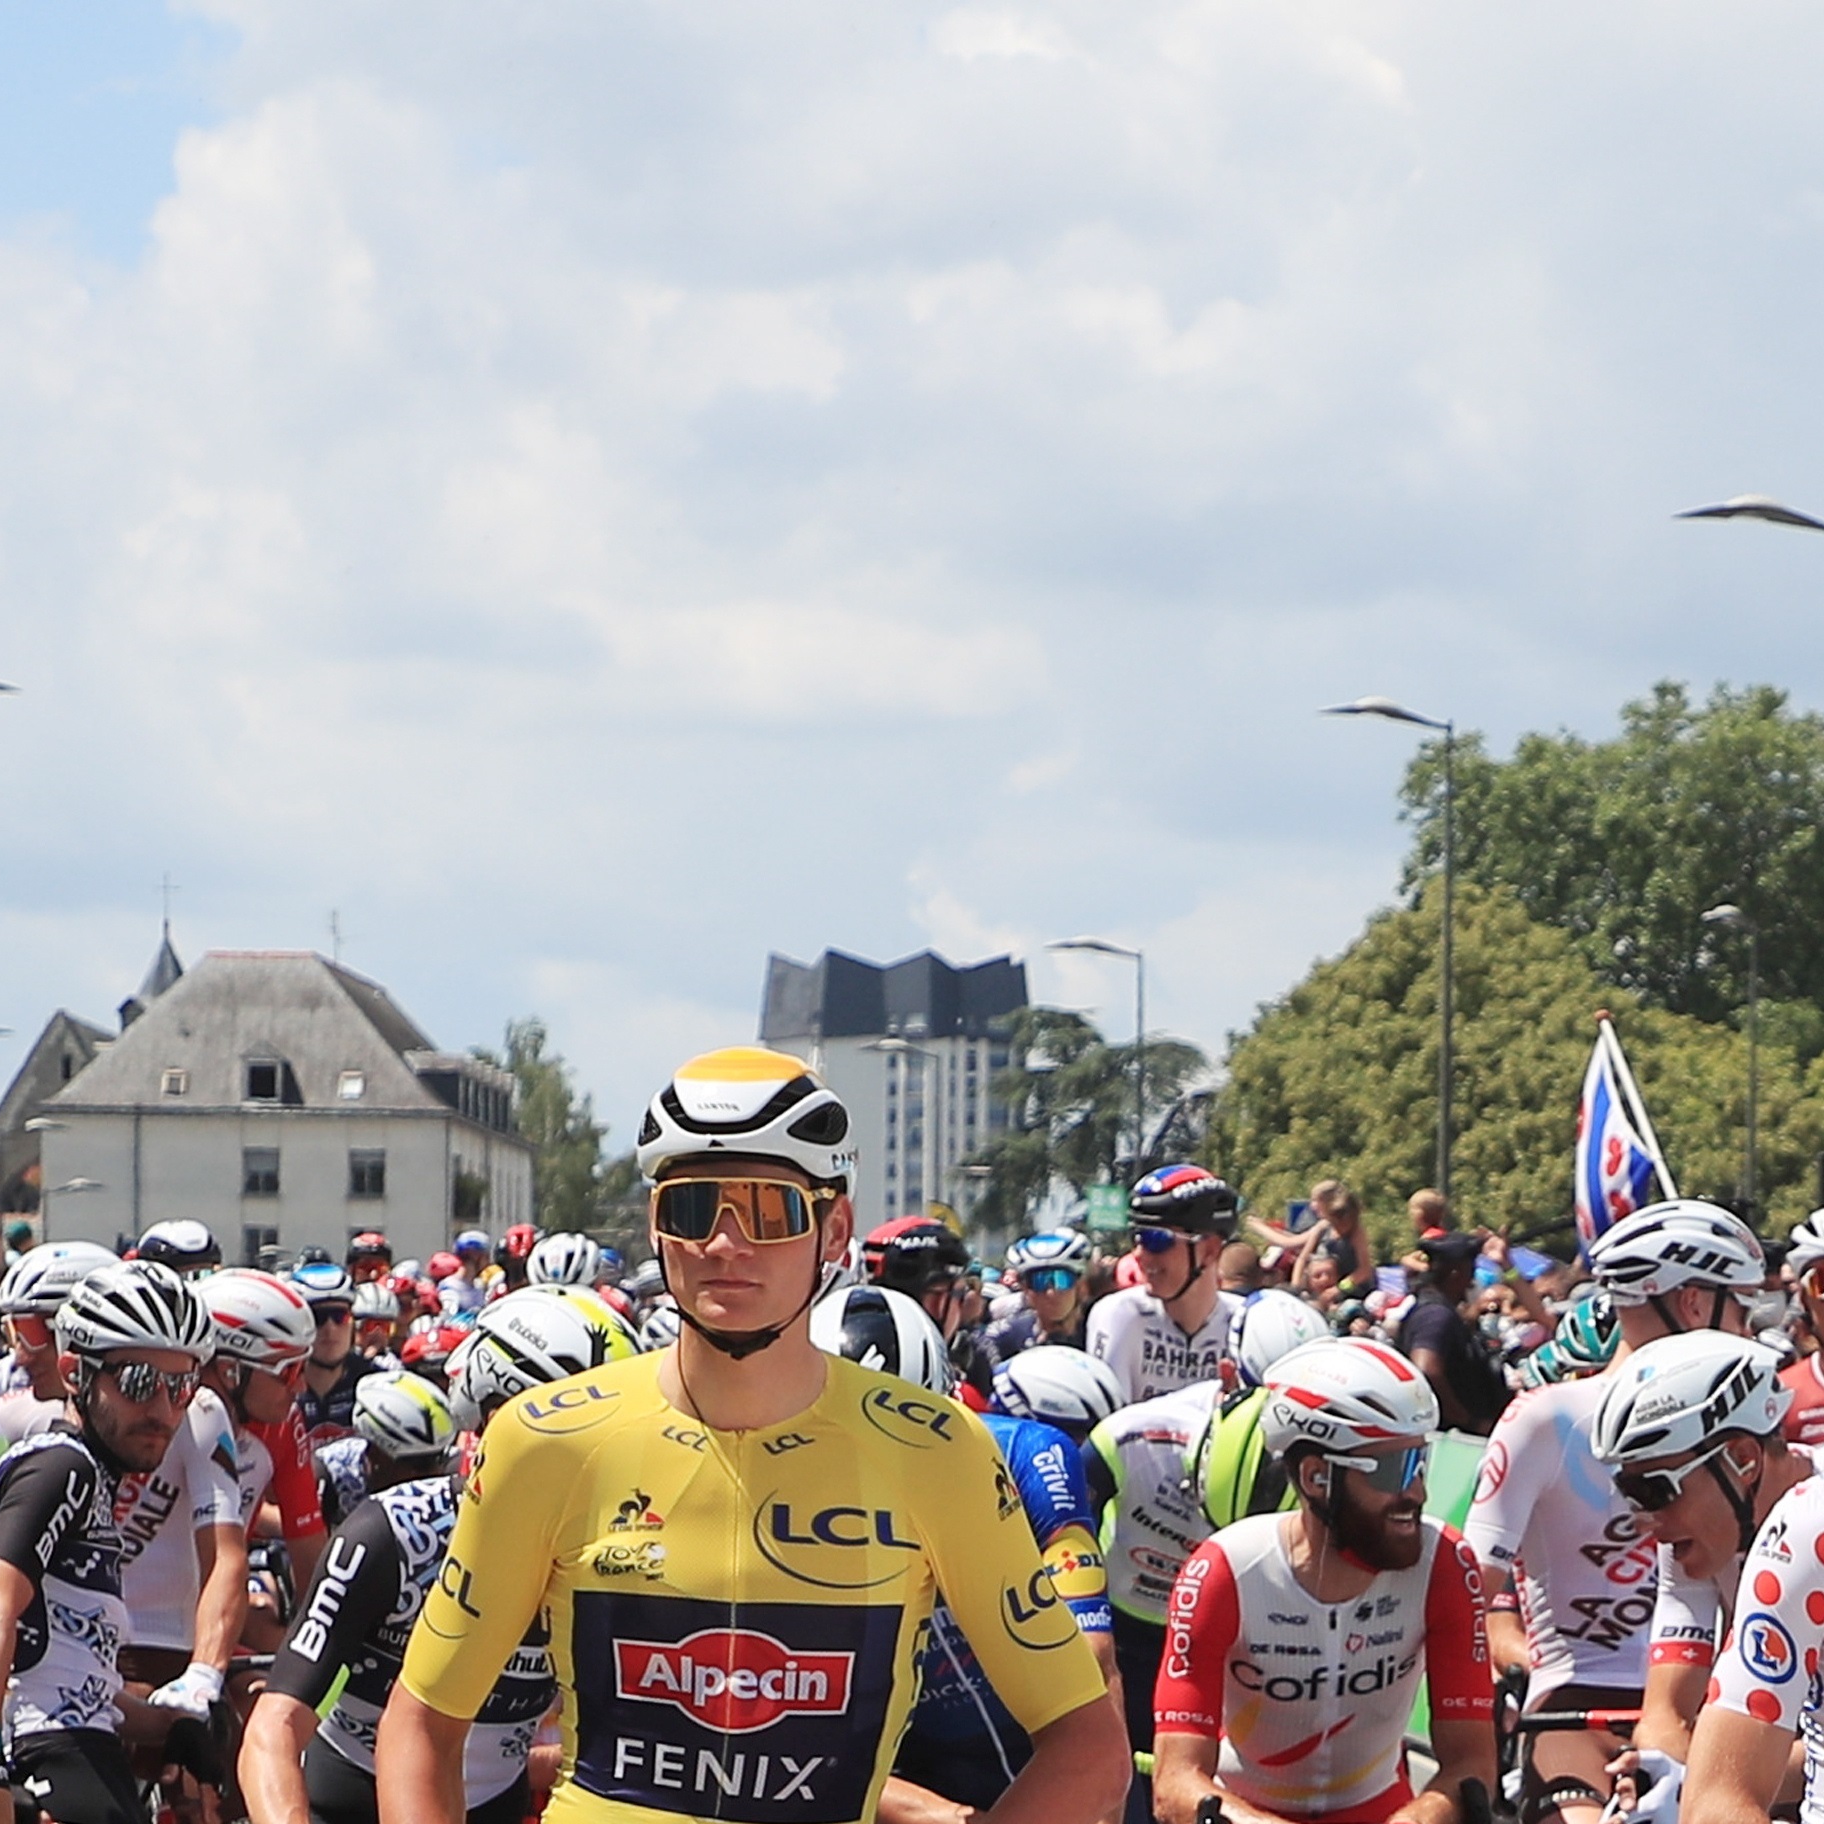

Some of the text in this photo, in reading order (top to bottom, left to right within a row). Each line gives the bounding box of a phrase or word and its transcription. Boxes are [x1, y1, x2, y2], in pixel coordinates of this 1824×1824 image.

[1660, 1241, 1745, 1280] HJC
[523, 1385, 620, 1420] LCL
[873, 1390, 953, 1442] LCL
[661, 1425, 707, 1453] LCL
[762, 1432, 816, 1456] LCL
[771, 1503, 921, 1551] LCL
[1167, 1556, 1211, 1678] Cofidis
[638, 1652, 829, 1708] Alpecin
[1230, 1654, 1417, 1702] Cofidis
[613, 1736, 824, 1801] FENIX
